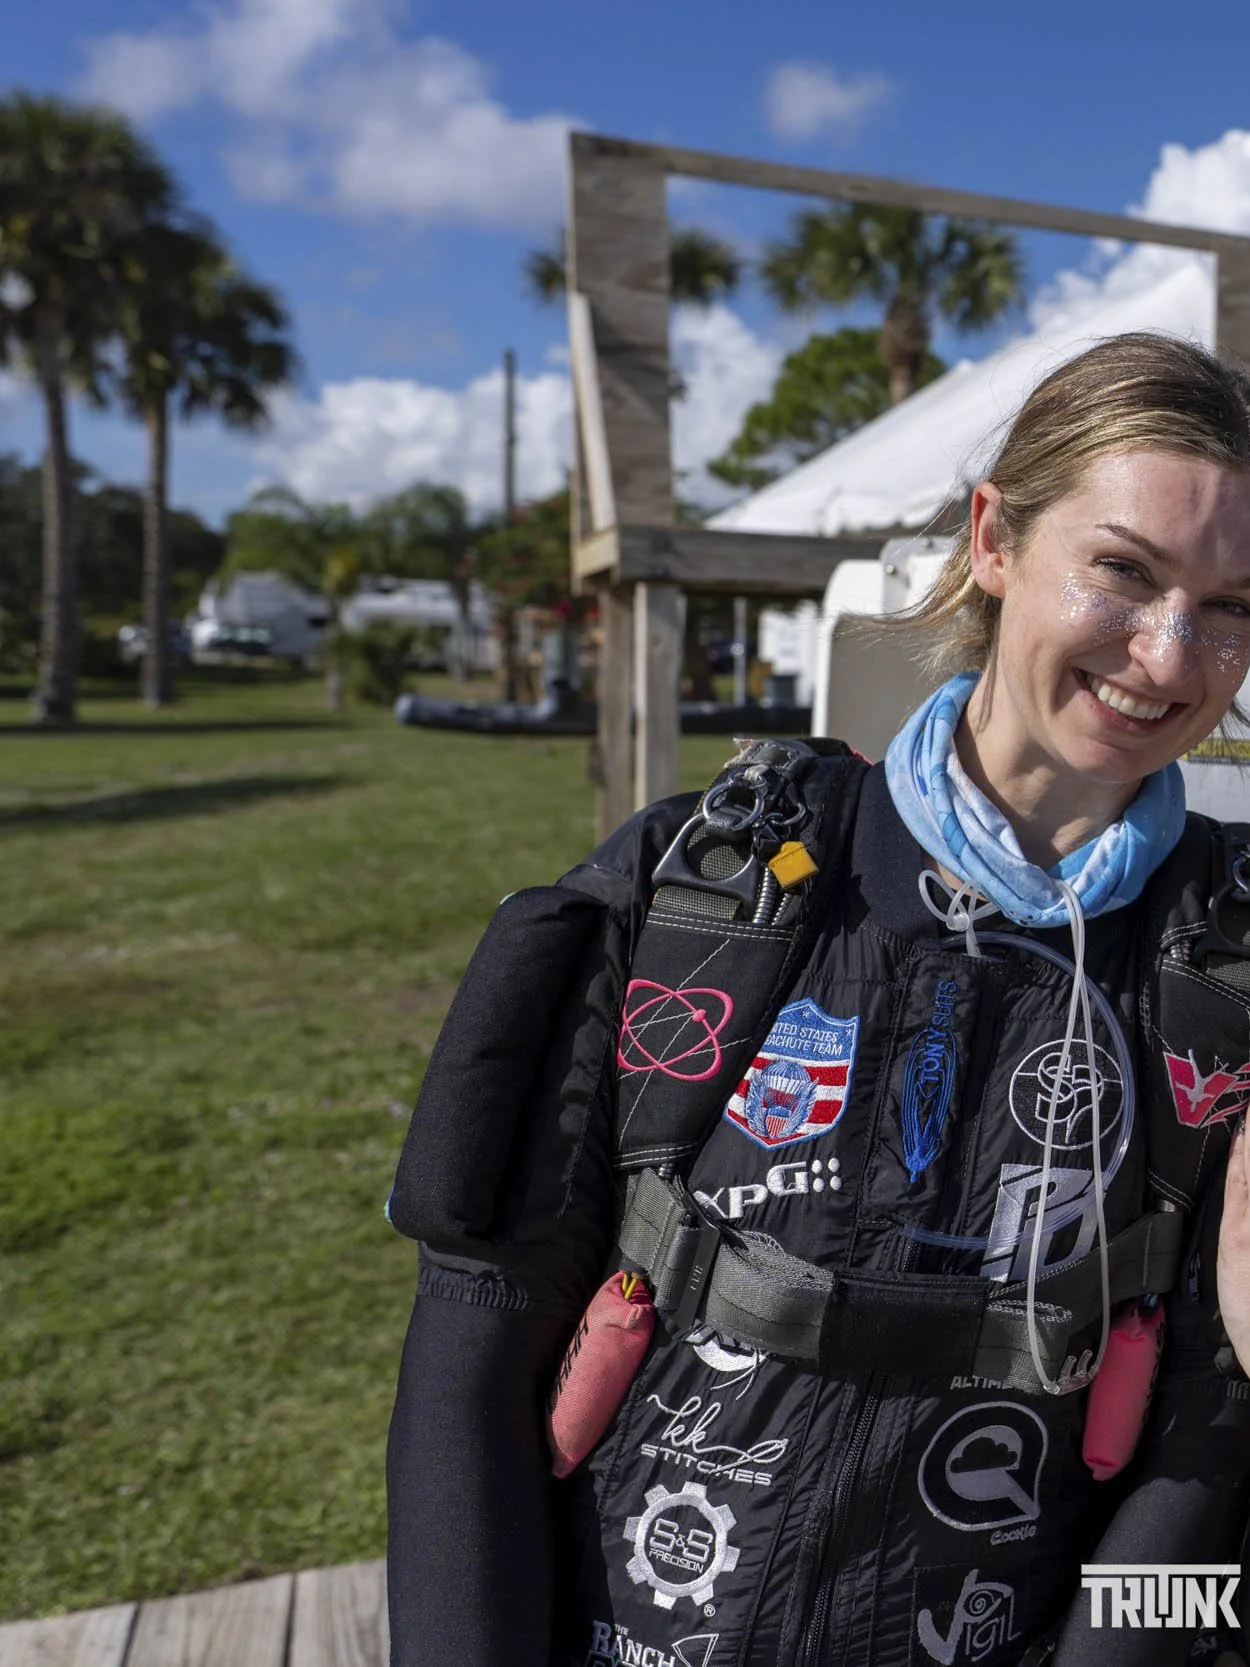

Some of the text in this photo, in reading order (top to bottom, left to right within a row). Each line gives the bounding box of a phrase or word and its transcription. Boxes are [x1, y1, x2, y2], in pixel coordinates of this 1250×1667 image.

[766, 1034, 843, 1056] ACHUTE TEAM
[773, 1022, 838, 1043] ITED STATES
[641, 1443, 773, 1487] STITCHES
[649, 1517, 714, 1563] S&S
[648, 1547, 704, 1574] PRECISION
